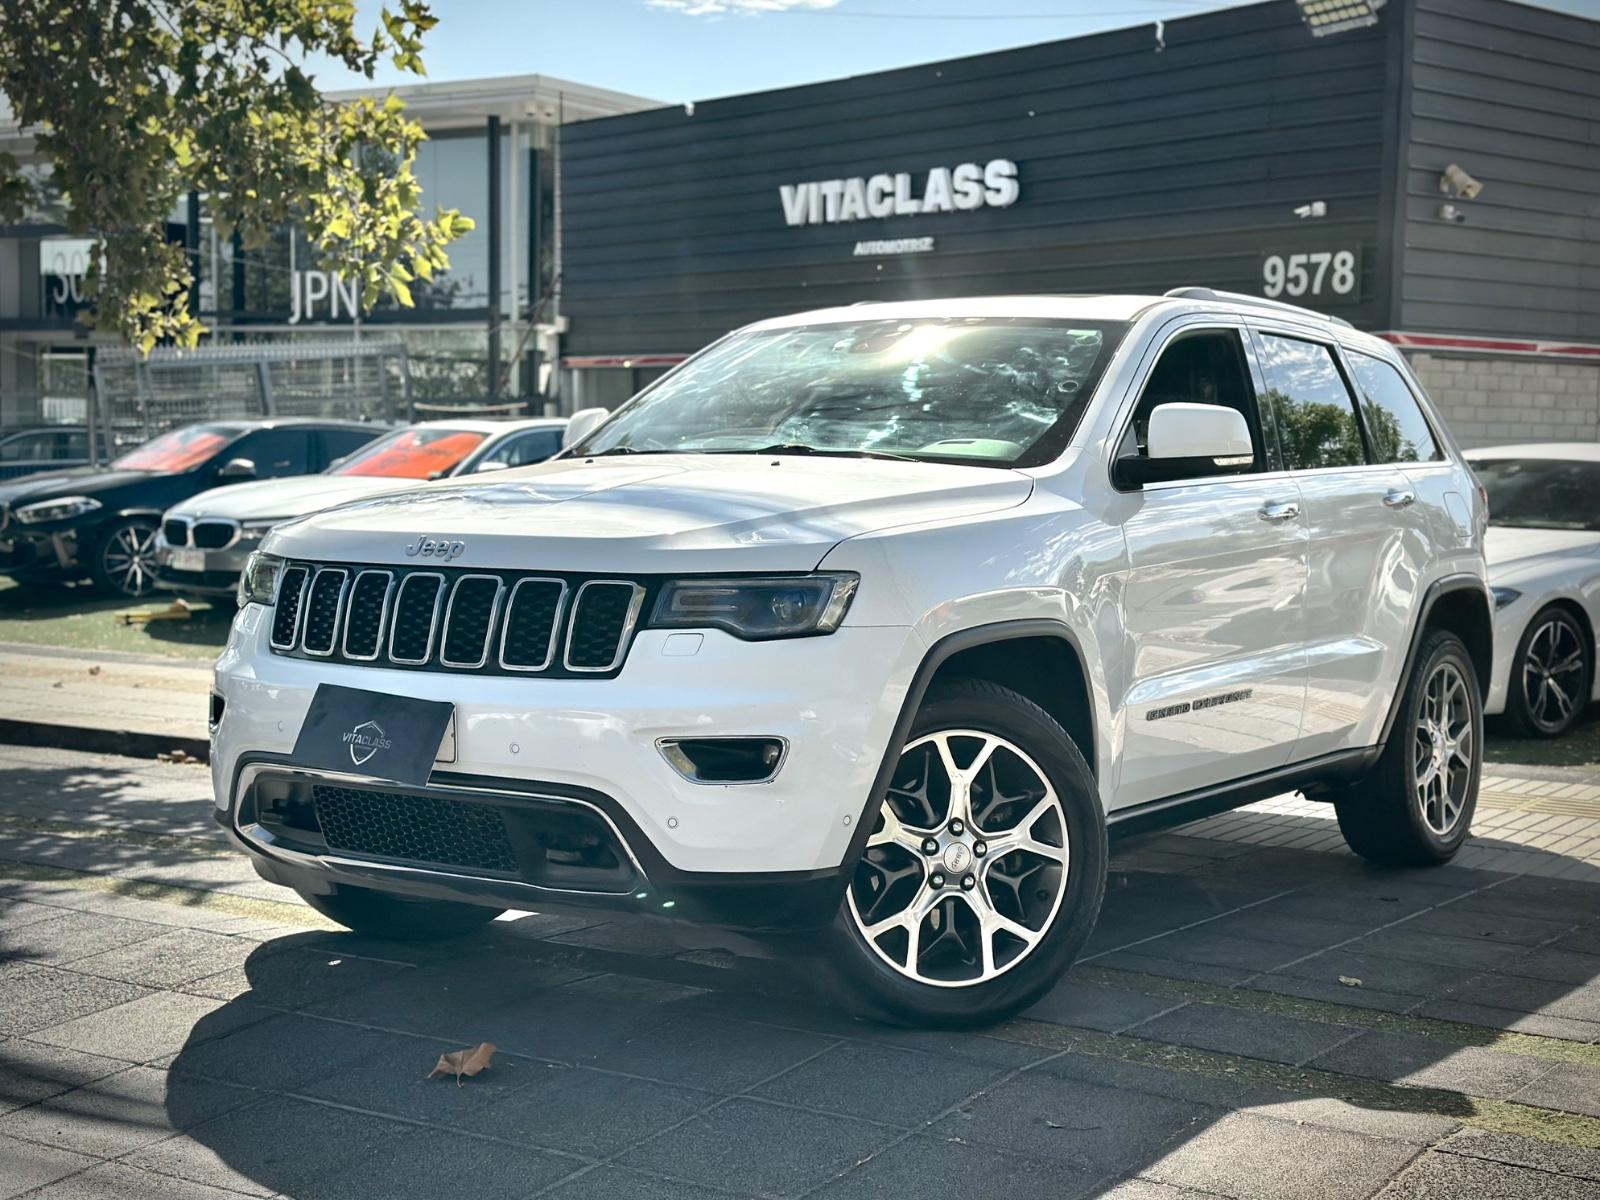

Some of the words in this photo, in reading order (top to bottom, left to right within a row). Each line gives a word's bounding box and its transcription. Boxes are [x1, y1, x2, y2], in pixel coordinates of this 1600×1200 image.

[779, 159, 1020, 226] VITACLASS
[1263, 250, 1355, 298] 9578
[288, 270, 357, 325] JPN
[405, 534, 465, 562] Jeep
[1146, 702, 1191, 721] GRAND
[342, 731, 392, 749] VITACLASS
